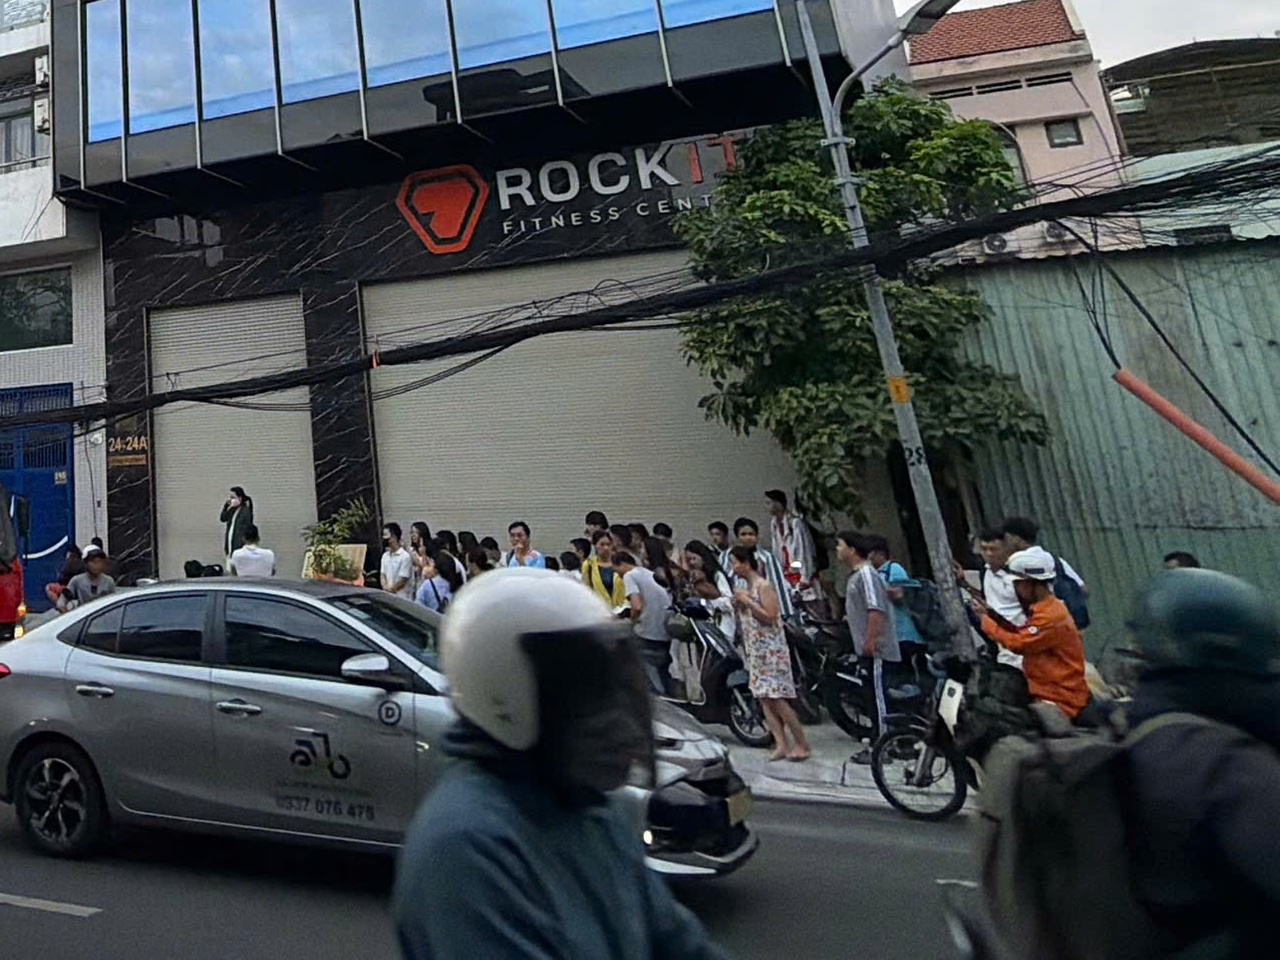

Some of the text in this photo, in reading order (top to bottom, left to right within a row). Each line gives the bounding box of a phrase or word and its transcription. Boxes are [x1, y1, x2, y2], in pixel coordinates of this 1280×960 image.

[496, 131, 747, 210] ROCKIT
[503, 194, 712, 234] FITNESS CENT
[315, 800, 342, 816] 076
